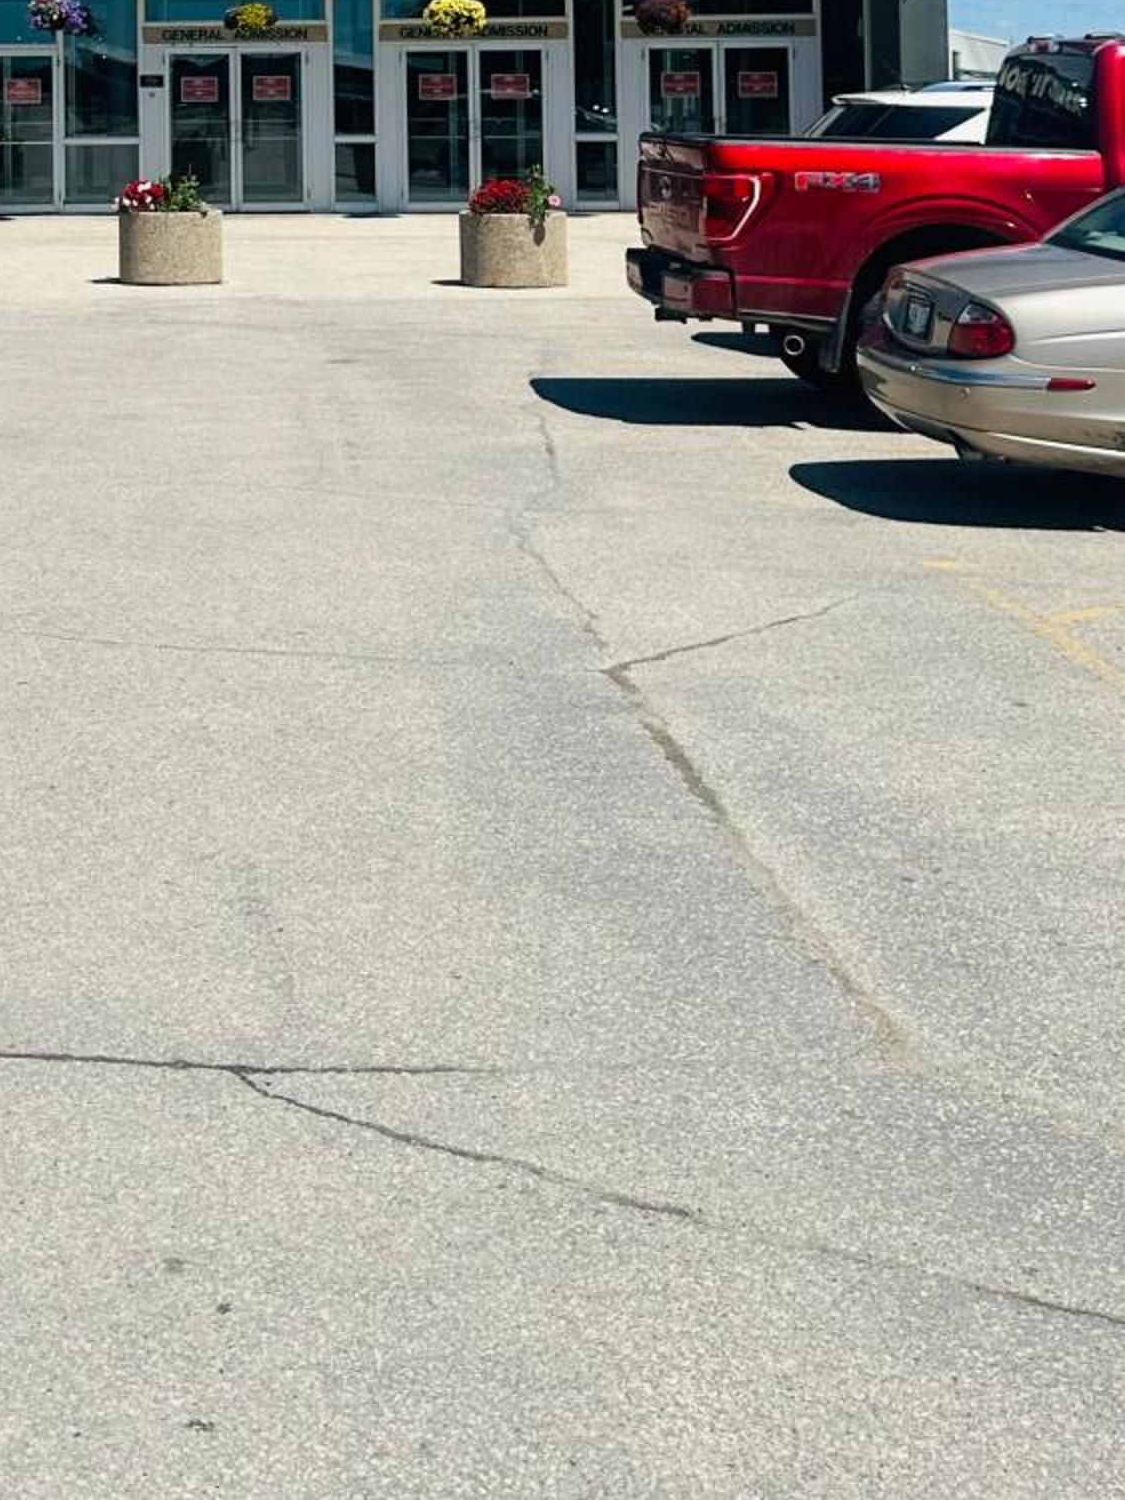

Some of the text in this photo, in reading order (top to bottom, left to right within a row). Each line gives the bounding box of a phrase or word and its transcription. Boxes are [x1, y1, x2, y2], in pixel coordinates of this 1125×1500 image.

[717, 20, 795, 33] ADMISSION
[162, 27, 308, 41] GENERAL ADMISSION
